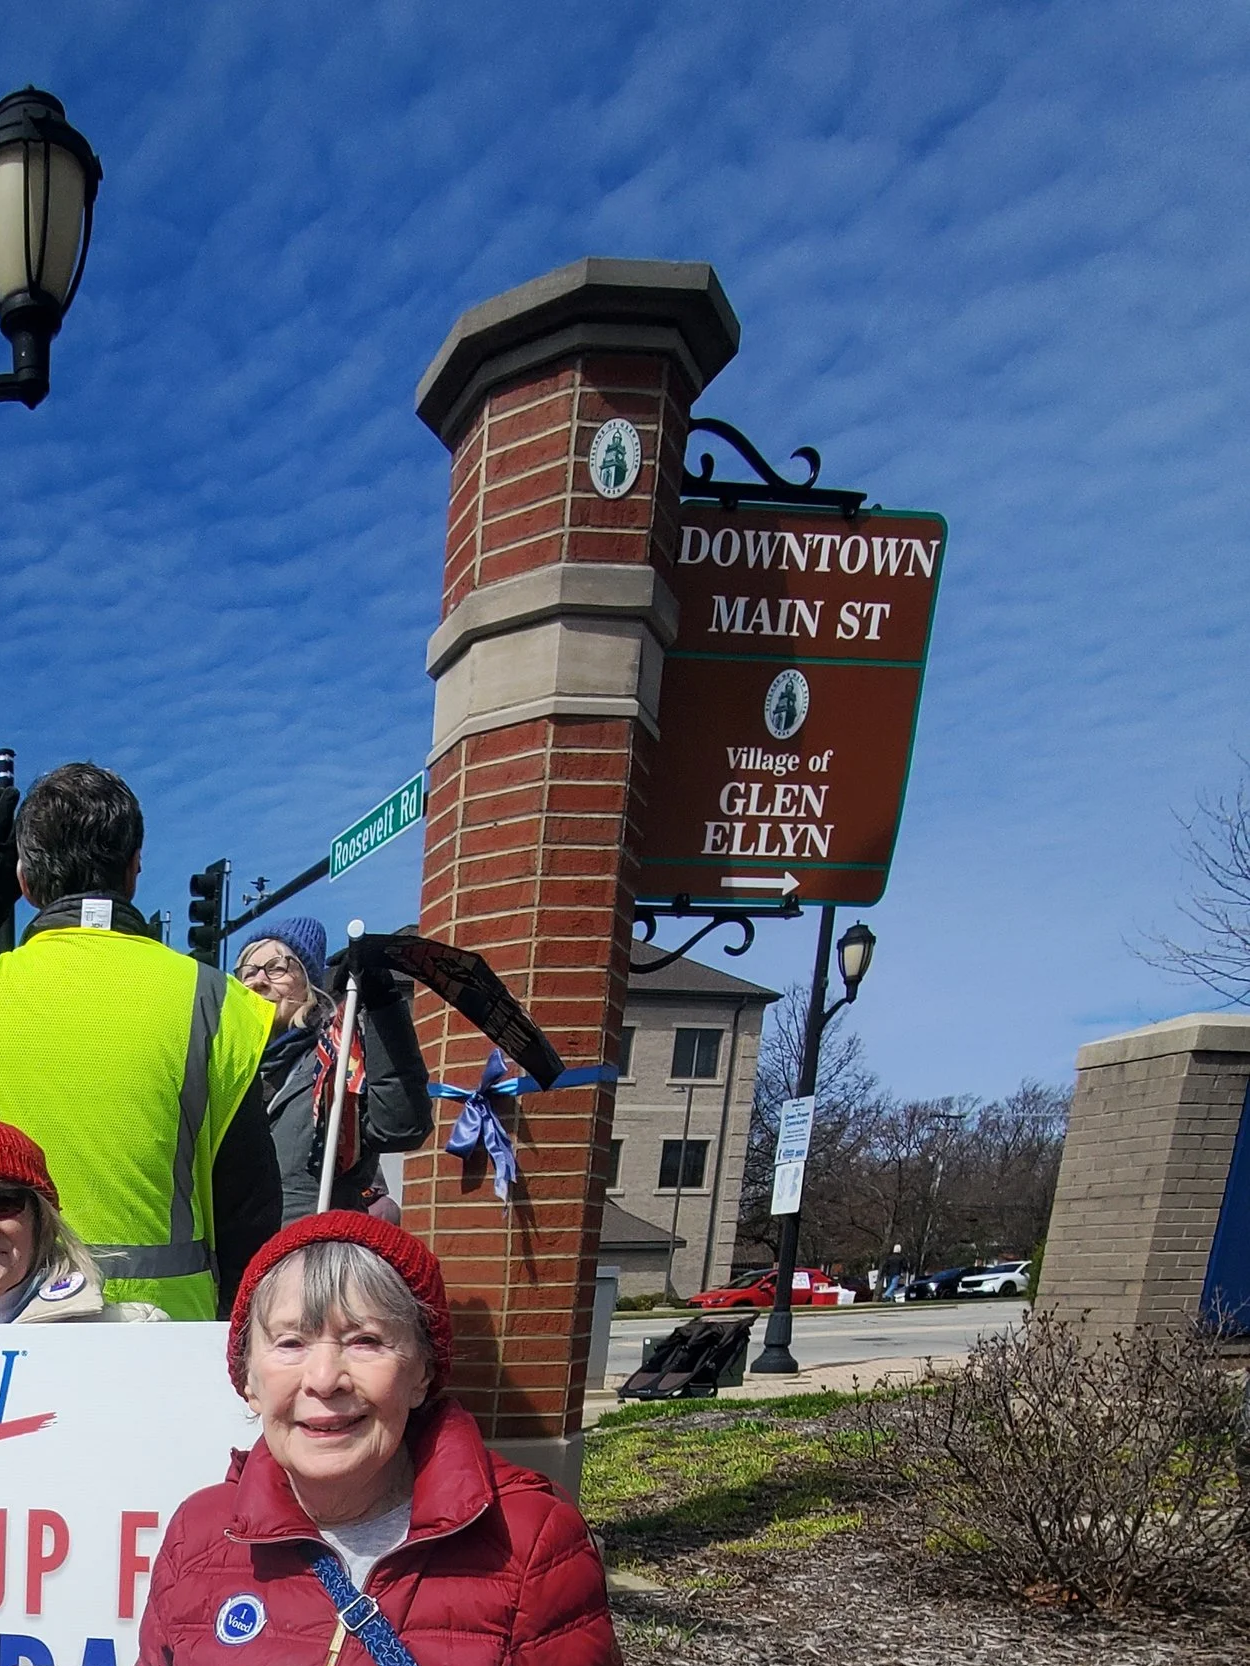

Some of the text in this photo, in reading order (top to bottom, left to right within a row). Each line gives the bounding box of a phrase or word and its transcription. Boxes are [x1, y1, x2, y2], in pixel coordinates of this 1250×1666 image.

[679, 525, 941, 579] DOWNTOWN
[707, 594, 891, 641] MAIN ST
[726, 746, 834, 776] Village of
[719, 783, 829, 818] GLEN
[334, 783, 417, 873] Roosevelt Rd
[701, 821, 834, 858] ELLYN
[228, 1614, 253, 1633] Voted
[241, 1609, 248, 1620] I
